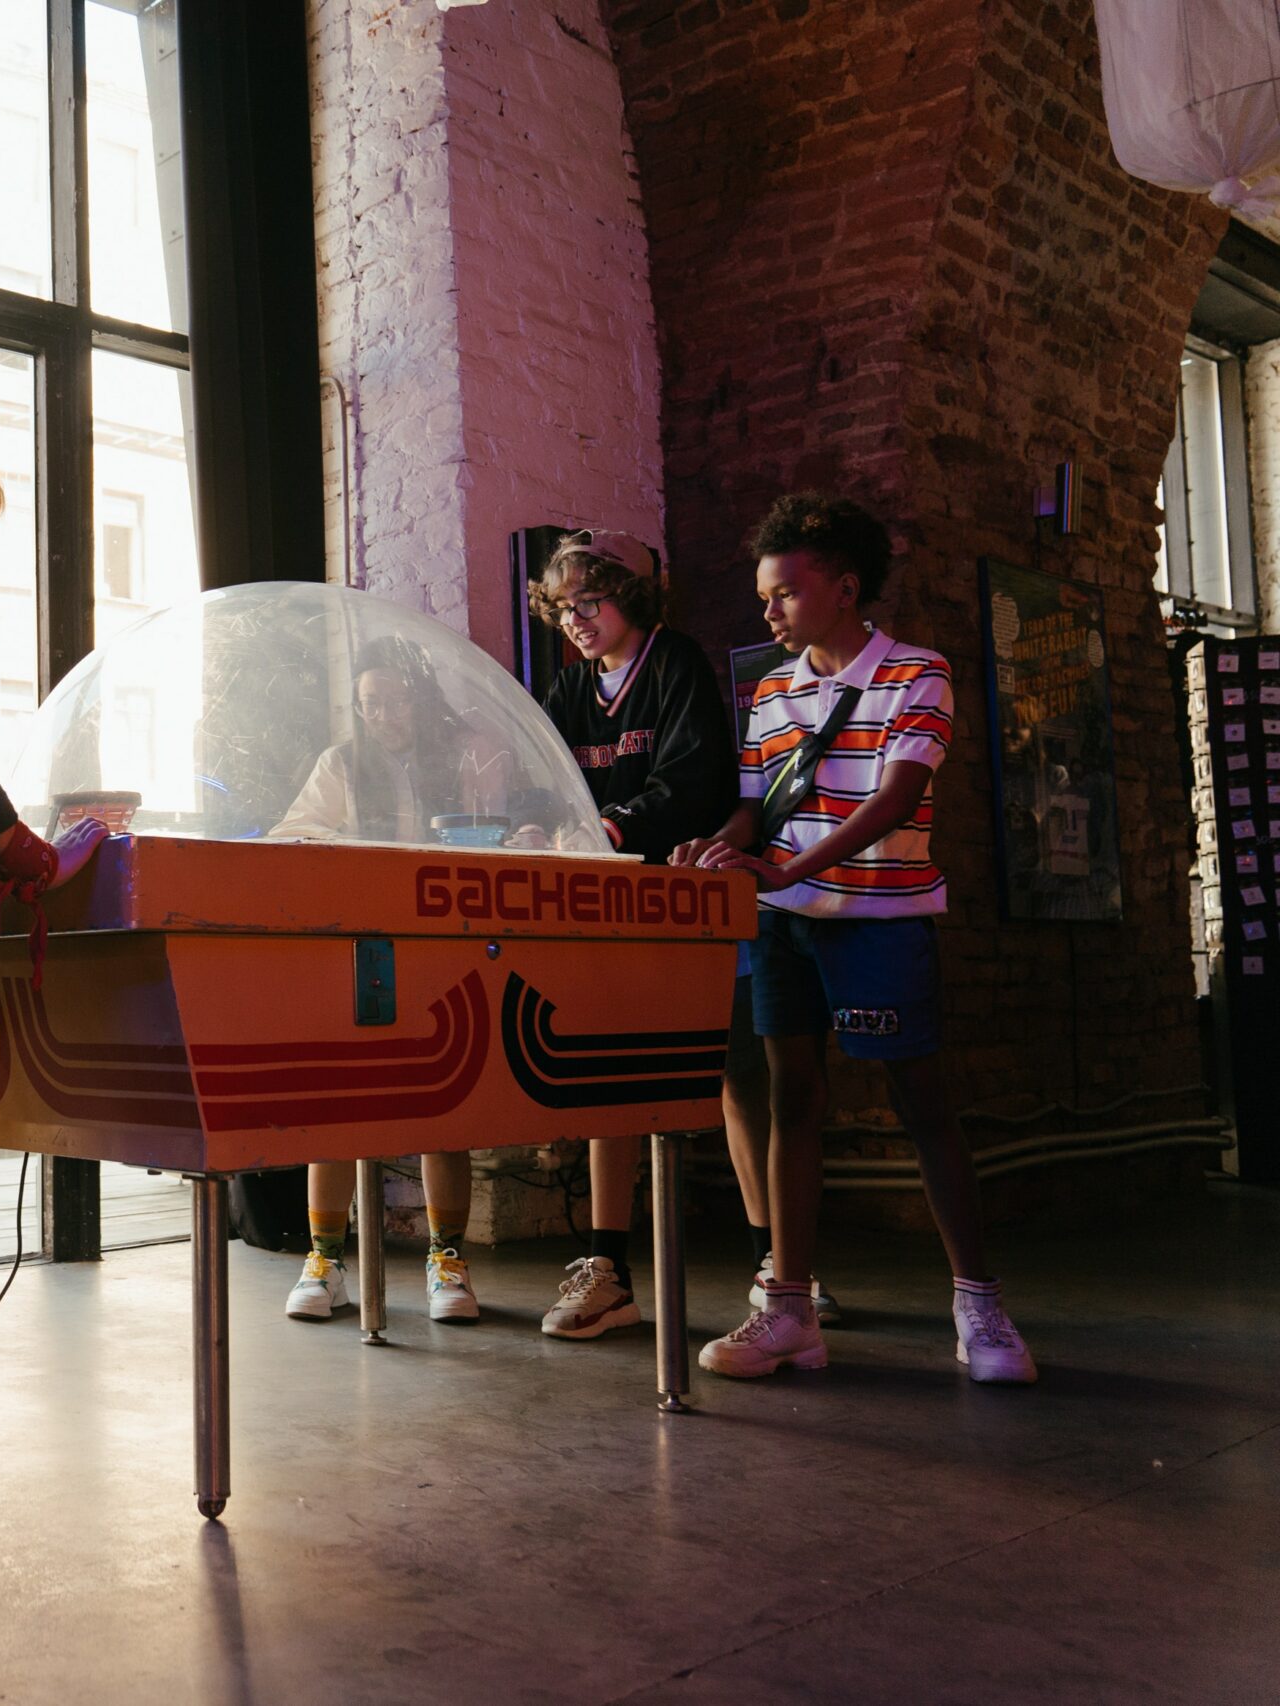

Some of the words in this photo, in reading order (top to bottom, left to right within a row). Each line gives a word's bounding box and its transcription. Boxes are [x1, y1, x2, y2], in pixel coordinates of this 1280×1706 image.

[1012, 637, 1047, 660] WHITE
[1048, 624, 1087, 656] RABBIT
[737, 695, 753, 709] 19
